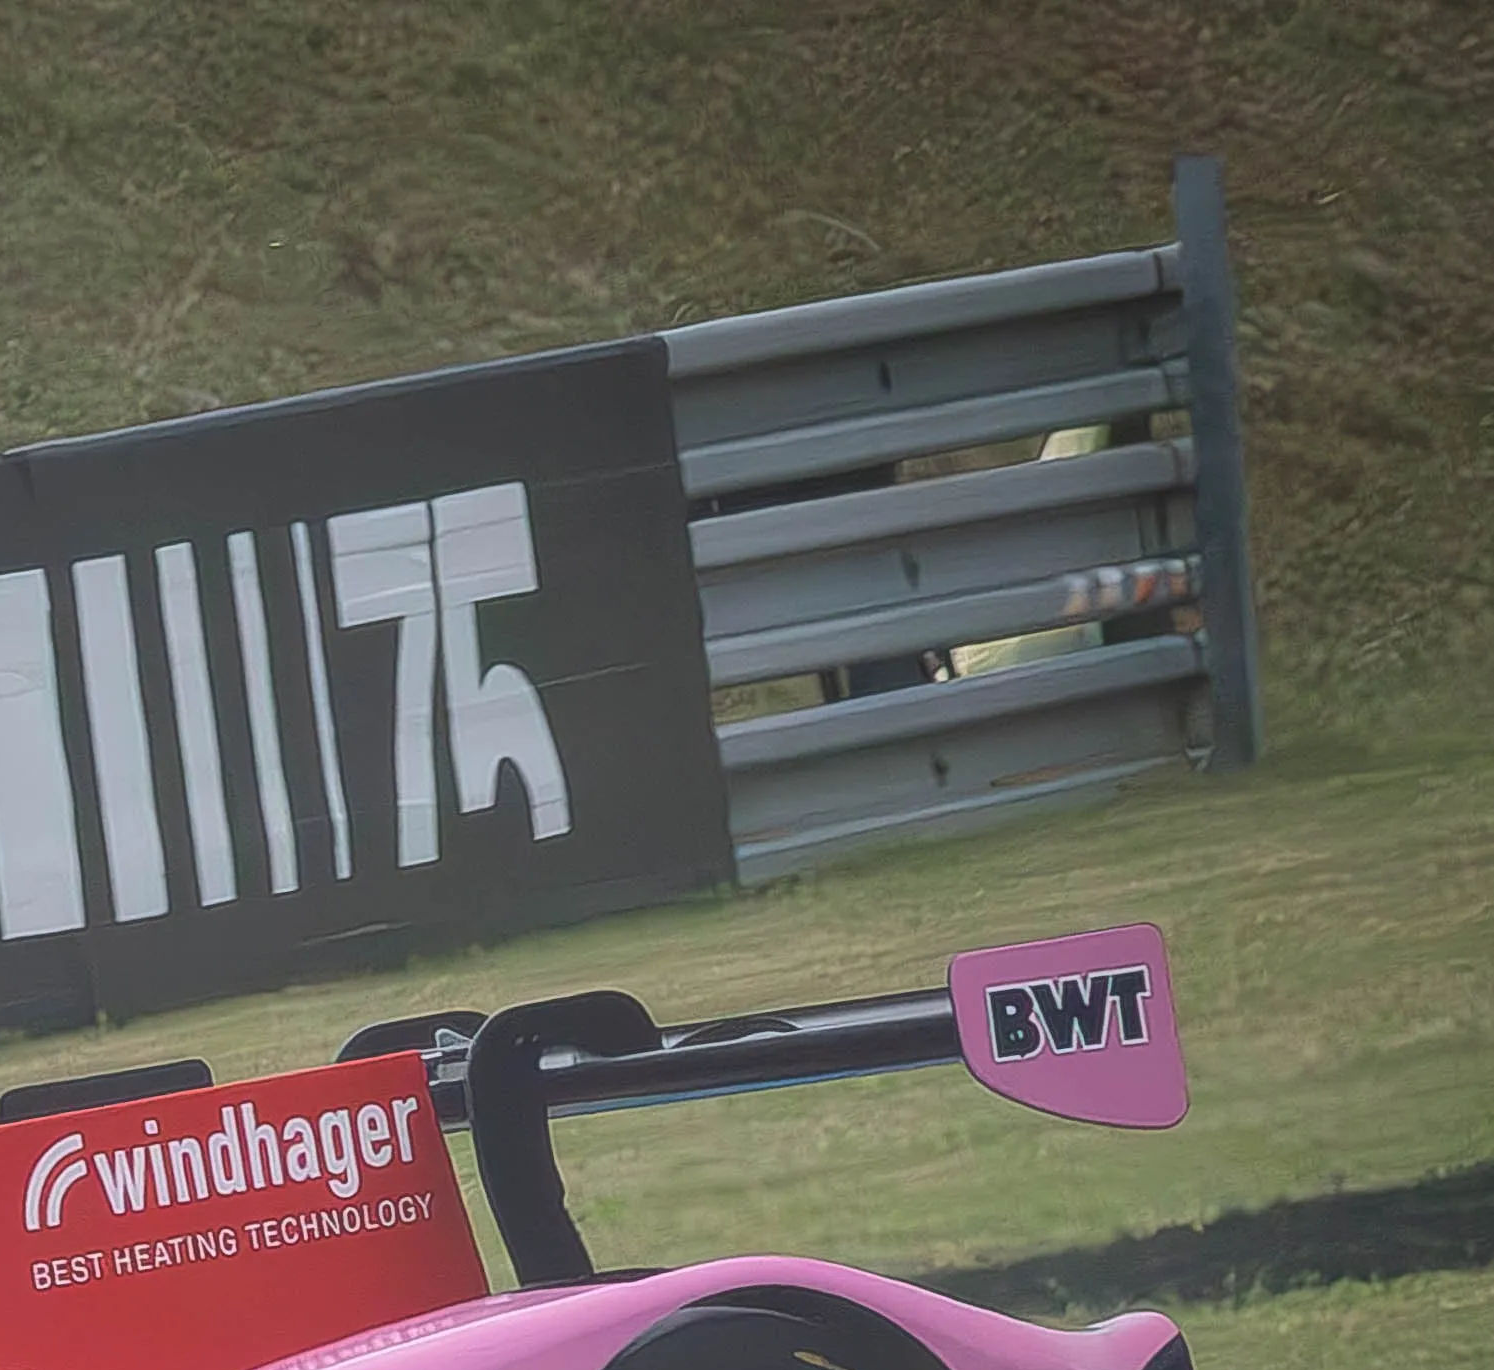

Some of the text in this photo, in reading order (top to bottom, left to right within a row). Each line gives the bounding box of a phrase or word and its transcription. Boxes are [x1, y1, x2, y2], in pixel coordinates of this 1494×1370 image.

[985, 964, 1152, 1063] BWT
[93, 1097, 420, 1215] windhager
[31, 1193, 432, 1290] BEST HEATING TECHNOLOGY
